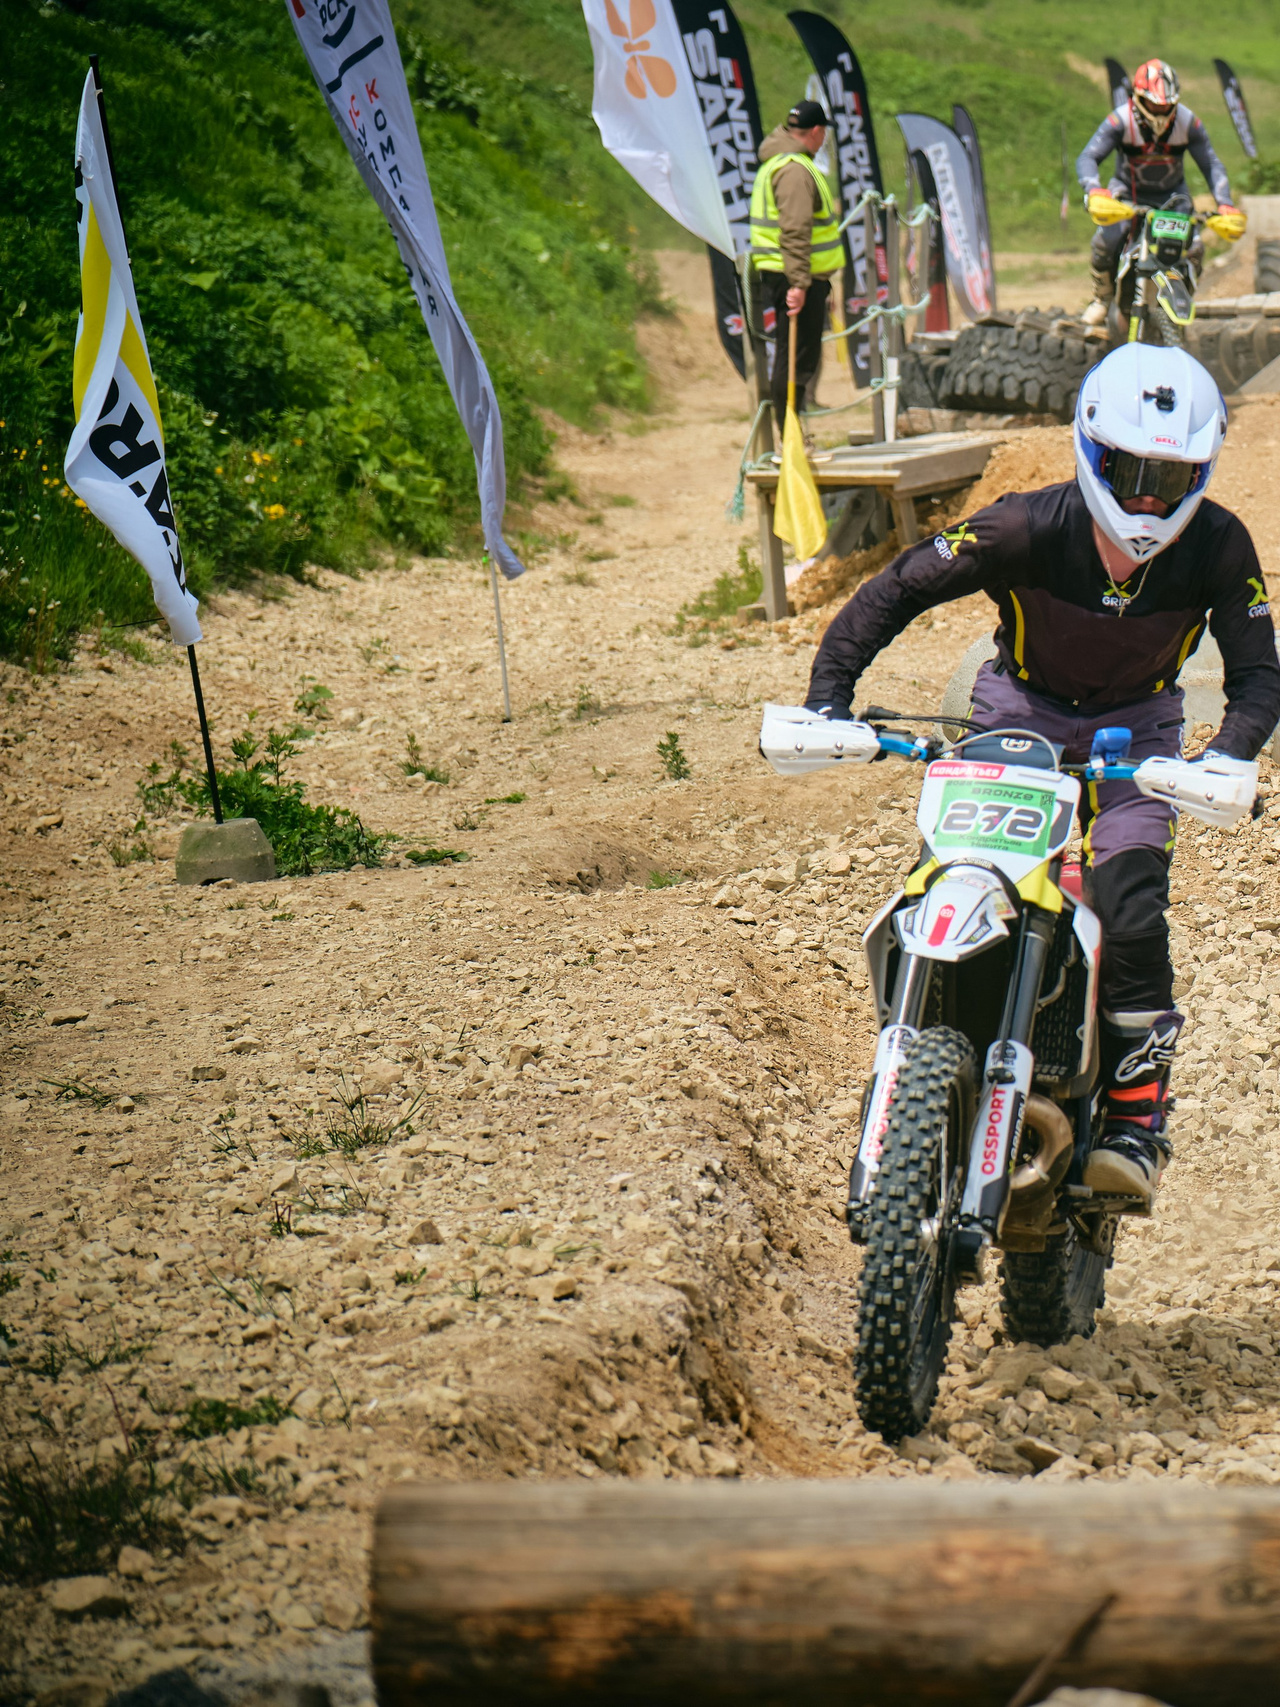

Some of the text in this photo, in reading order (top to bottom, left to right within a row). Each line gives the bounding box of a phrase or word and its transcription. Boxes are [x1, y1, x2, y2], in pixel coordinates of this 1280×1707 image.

[1155, 218, 1188, 233] 234
[1155, 436, 1178, 446] BELL
[933, 535, 954, 561] GRIP
[940, 800, 1046, 842] 272
[980, 1086, 1008, 1176] OSSPORT
